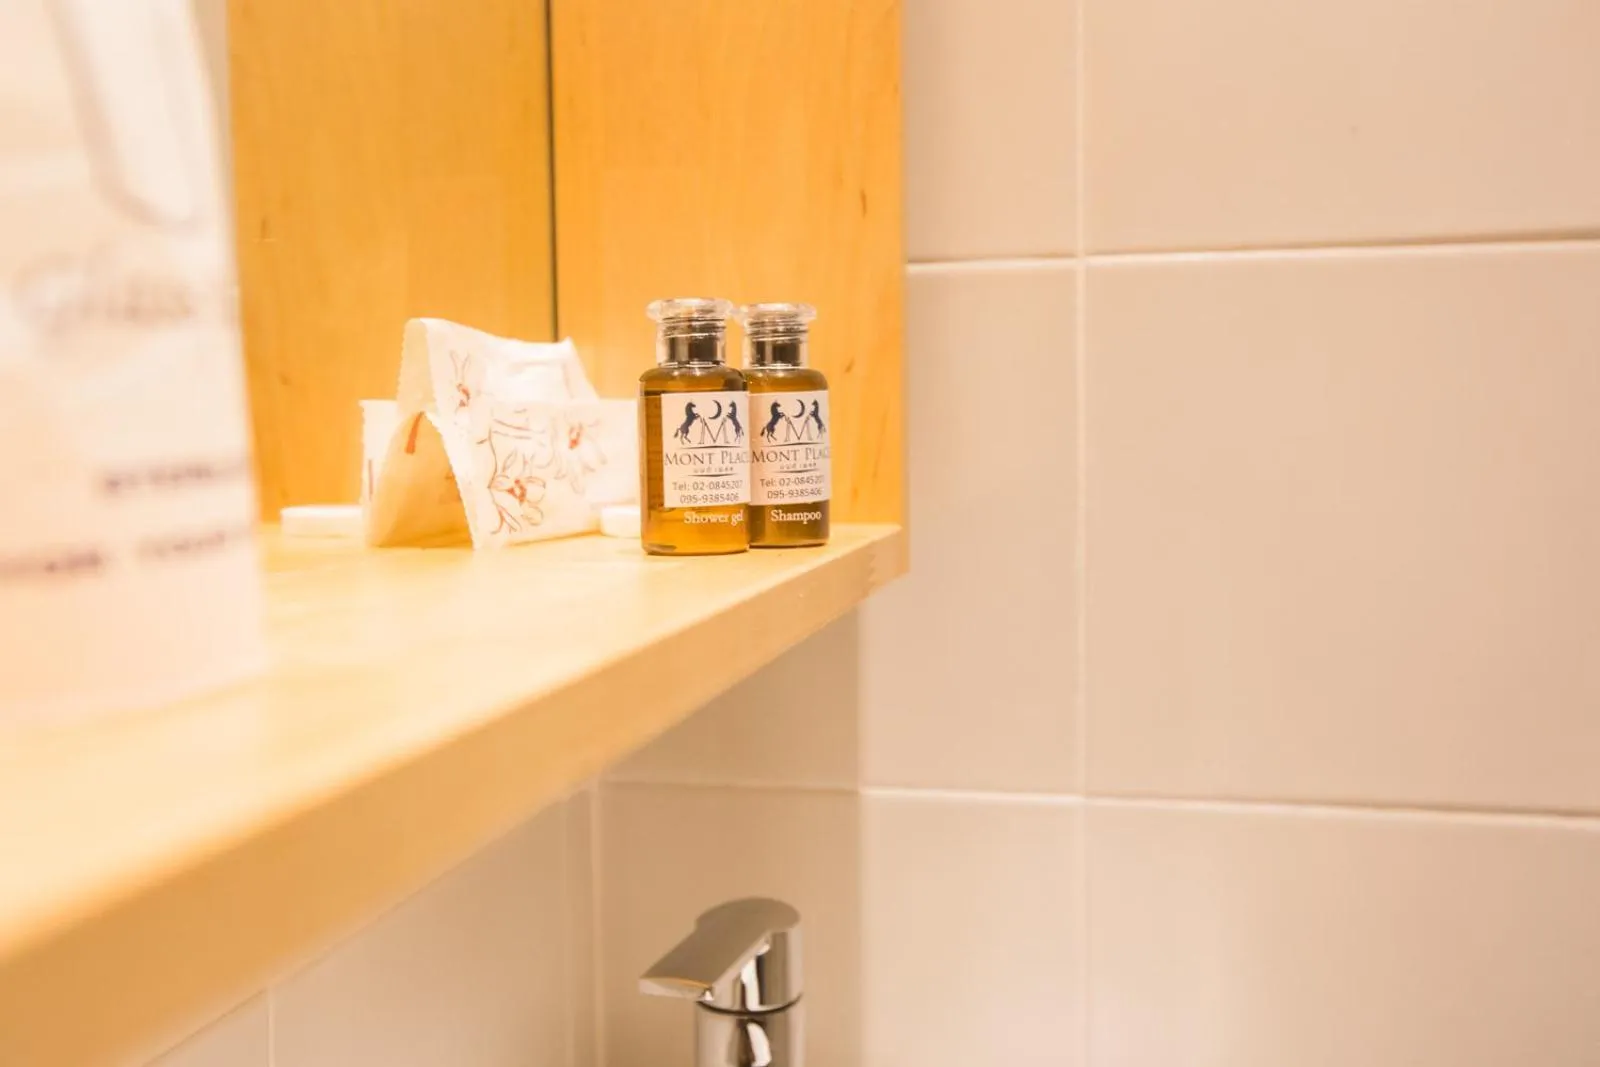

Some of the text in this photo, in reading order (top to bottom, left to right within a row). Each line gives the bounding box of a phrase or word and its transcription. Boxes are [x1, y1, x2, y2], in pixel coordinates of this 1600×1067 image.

[664, 449, 750, 466] MONT PLAC
[751, 449, 801, 463] MONT
[671, 481, 690, 491] Tel:
[683, 510, 729, 524] Shower
[770, 509, 822, 525] Shampoo
